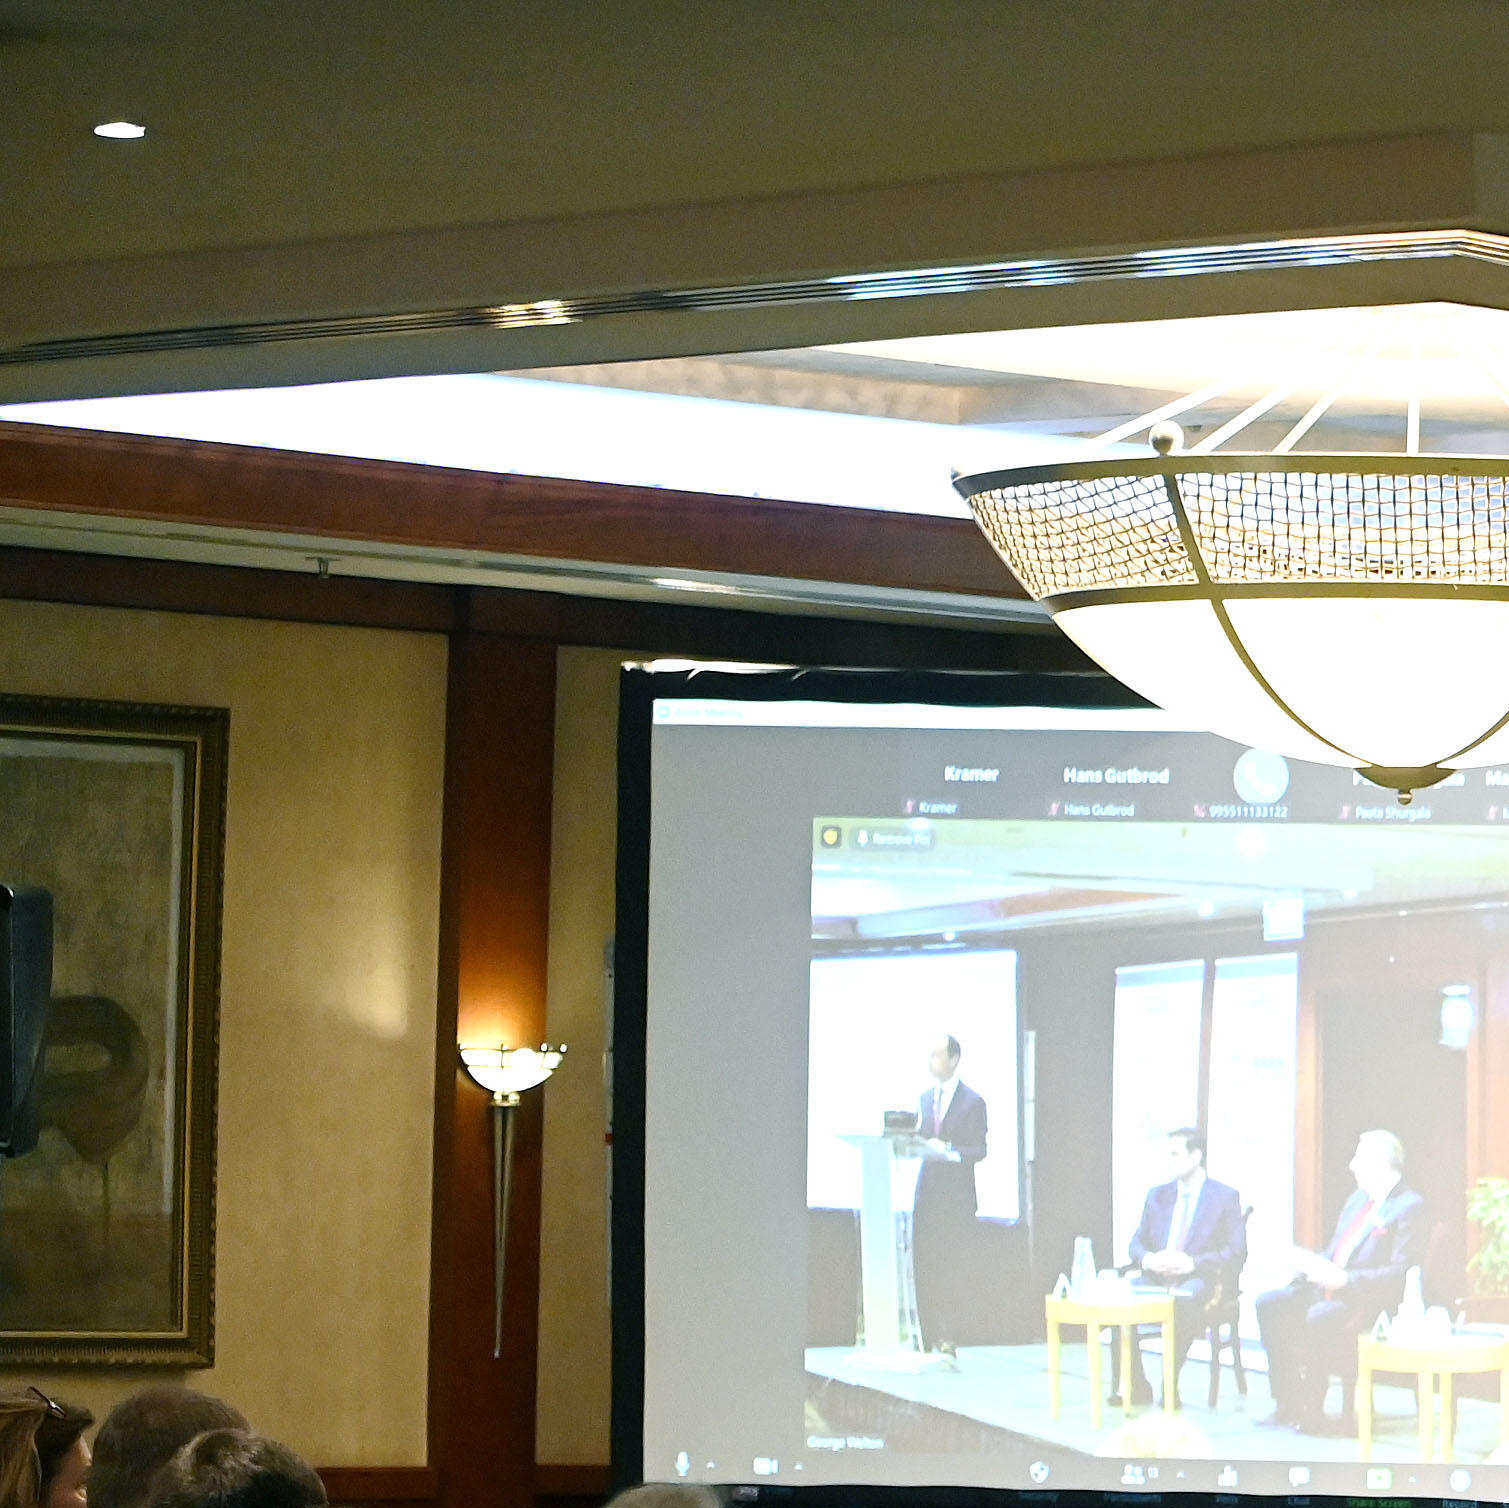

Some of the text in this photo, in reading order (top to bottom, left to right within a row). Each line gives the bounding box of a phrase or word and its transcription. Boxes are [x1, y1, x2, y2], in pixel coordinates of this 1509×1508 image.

[944, 766, 999, 783] Kramer
[1064, 767, 1170, 784] Hans Gutbrod
[919, 803, 958, 815] Kramer
[1064, 804, 1135, 817] Hans Gutbrod
